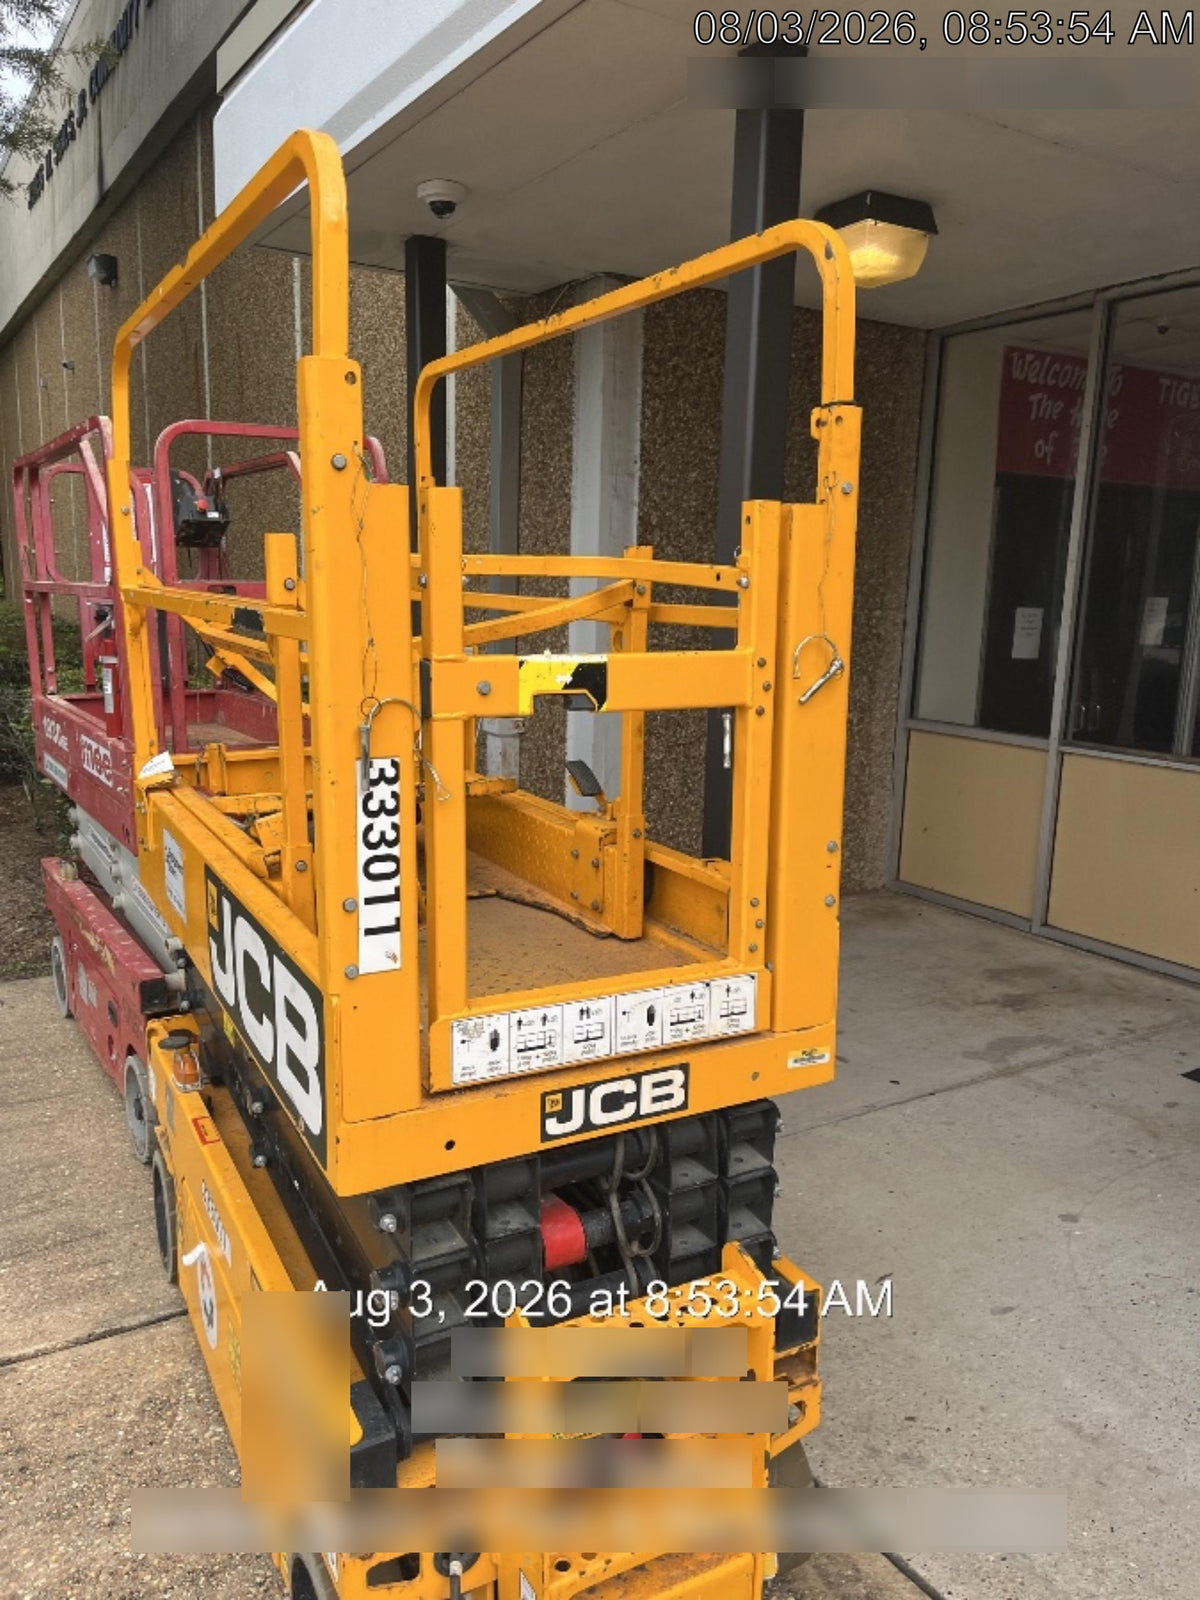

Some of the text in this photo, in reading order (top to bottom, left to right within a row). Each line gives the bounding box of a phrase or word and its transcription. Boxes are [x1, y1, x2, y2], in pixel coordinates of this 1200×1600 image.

[1009, 352, 1087, 391] Welcom
[1028, 393, 1064, 421] The
[1158, 377, 1200, 409] TIGE
[1034, 431, 1058, 465] of
[362, 758, 400, 936] 333011
[209, 896, 322, 1136] JCB
[545, 1069, 685, 1135] JCB
